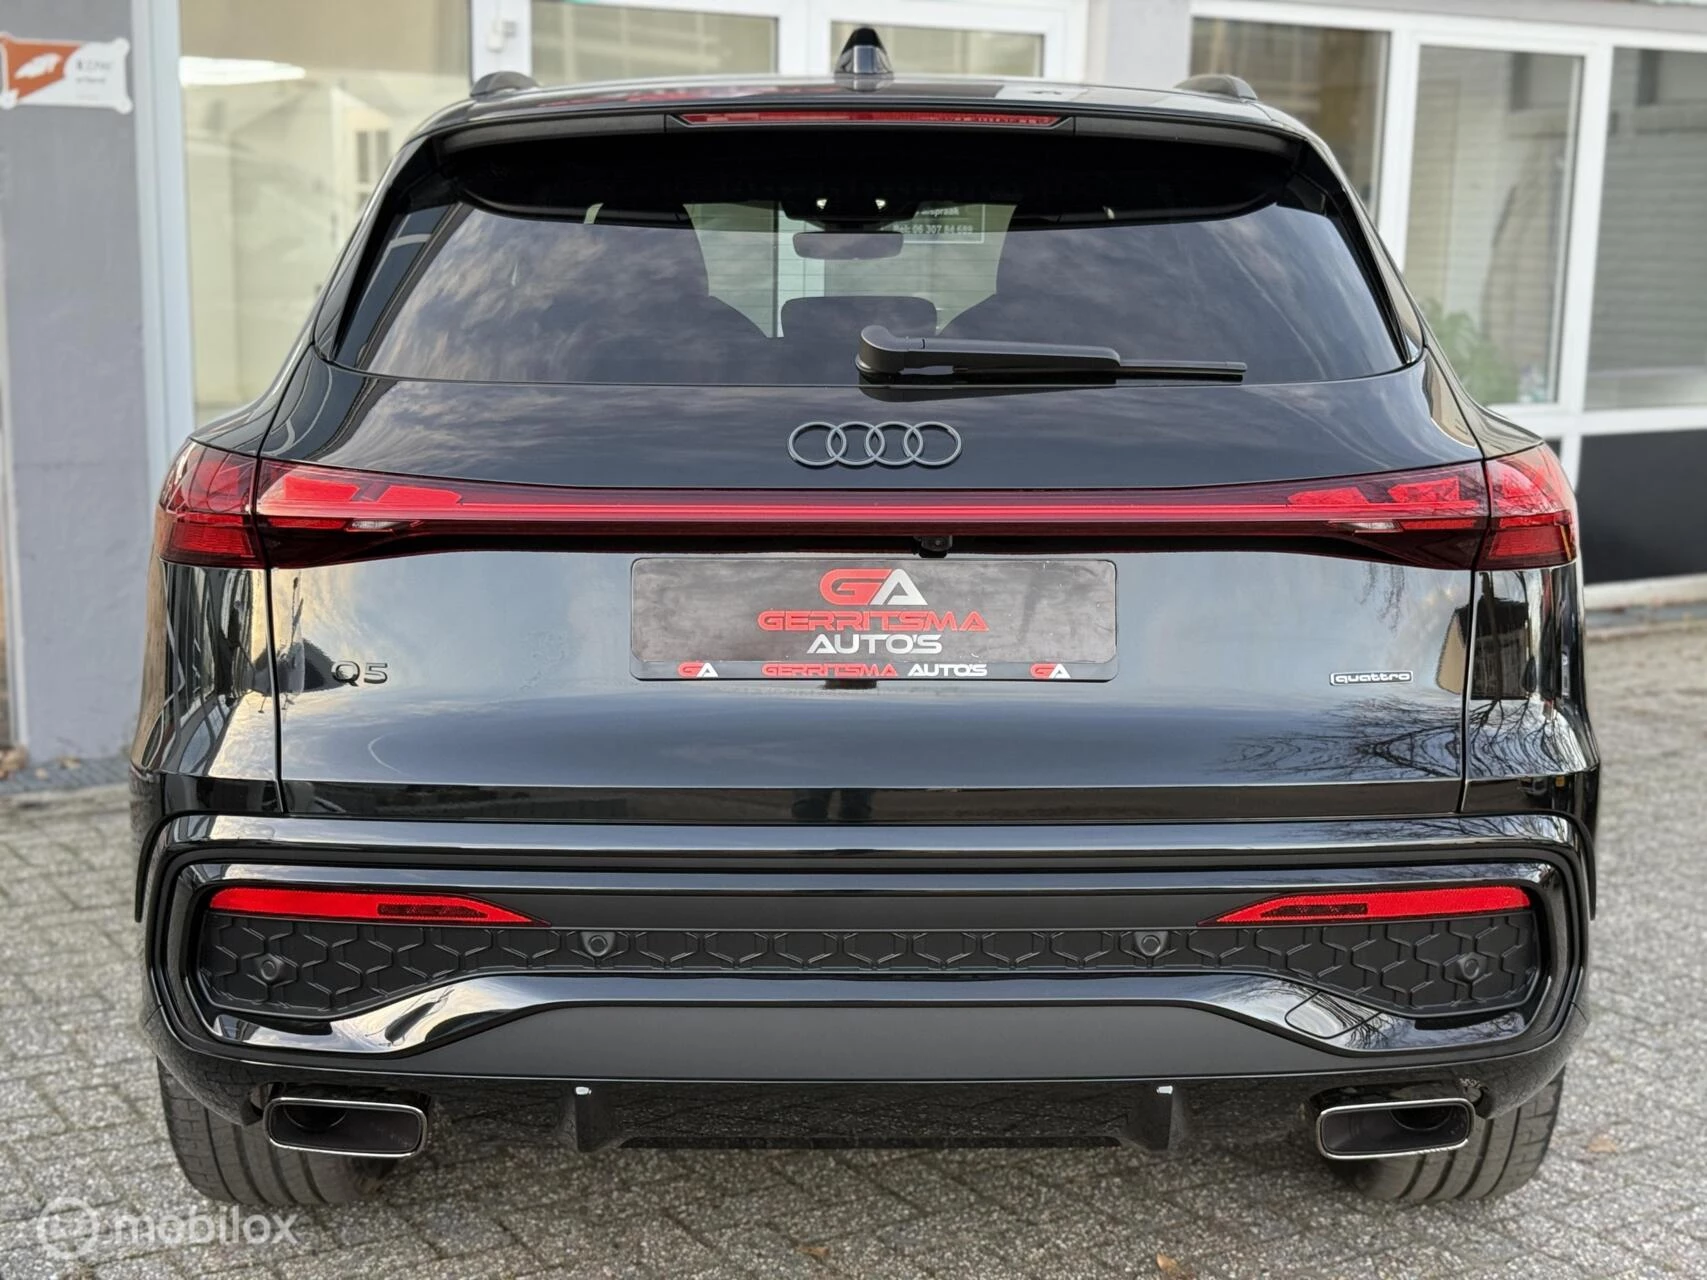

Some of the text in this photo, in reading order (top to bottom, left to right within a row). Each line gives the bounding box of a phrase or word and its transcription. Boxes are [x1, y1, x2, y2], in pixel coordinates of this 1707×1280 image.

[819, 568, 928, 606] GA
[757, 610, 990, 632] GERRITSMA
[806, 633, 943, 655] AUTO'S
[331, 660, 388, 687] Q5
[677, 661, 719, 678] GA
[761, 663, 988, 677] GERRITSMA AUTO'S
[1029, 662, 1072, 679] GA
[1335, 672, 1411, 684] quattro
